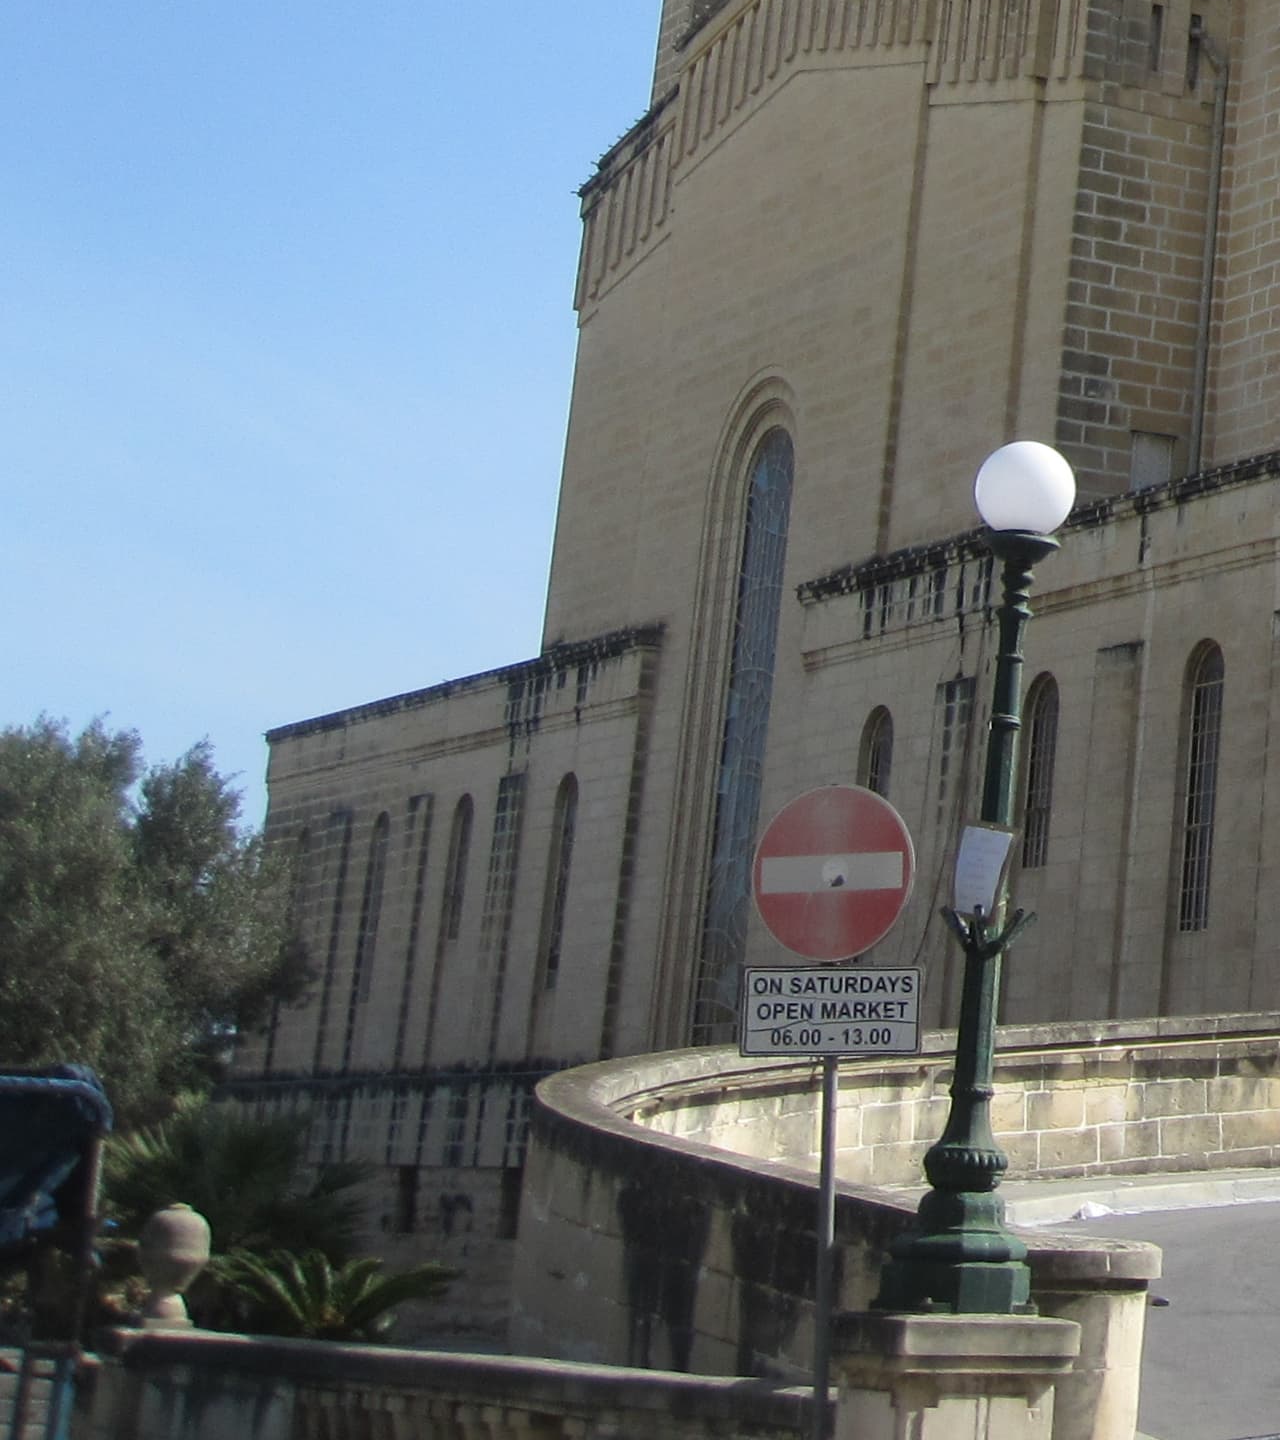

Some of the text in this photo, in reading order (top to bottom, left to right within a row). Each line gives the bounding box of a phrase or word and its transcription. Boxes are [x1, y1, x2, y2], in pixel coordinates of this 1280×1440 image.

[753, 976, 913, 995] ON SATURDAYS
[756, 1001, 909, 1021] OPEN MARKET
[770, 1028, 822, 1046] 06.00
[842, 1028, 891, 1045] 13.00
